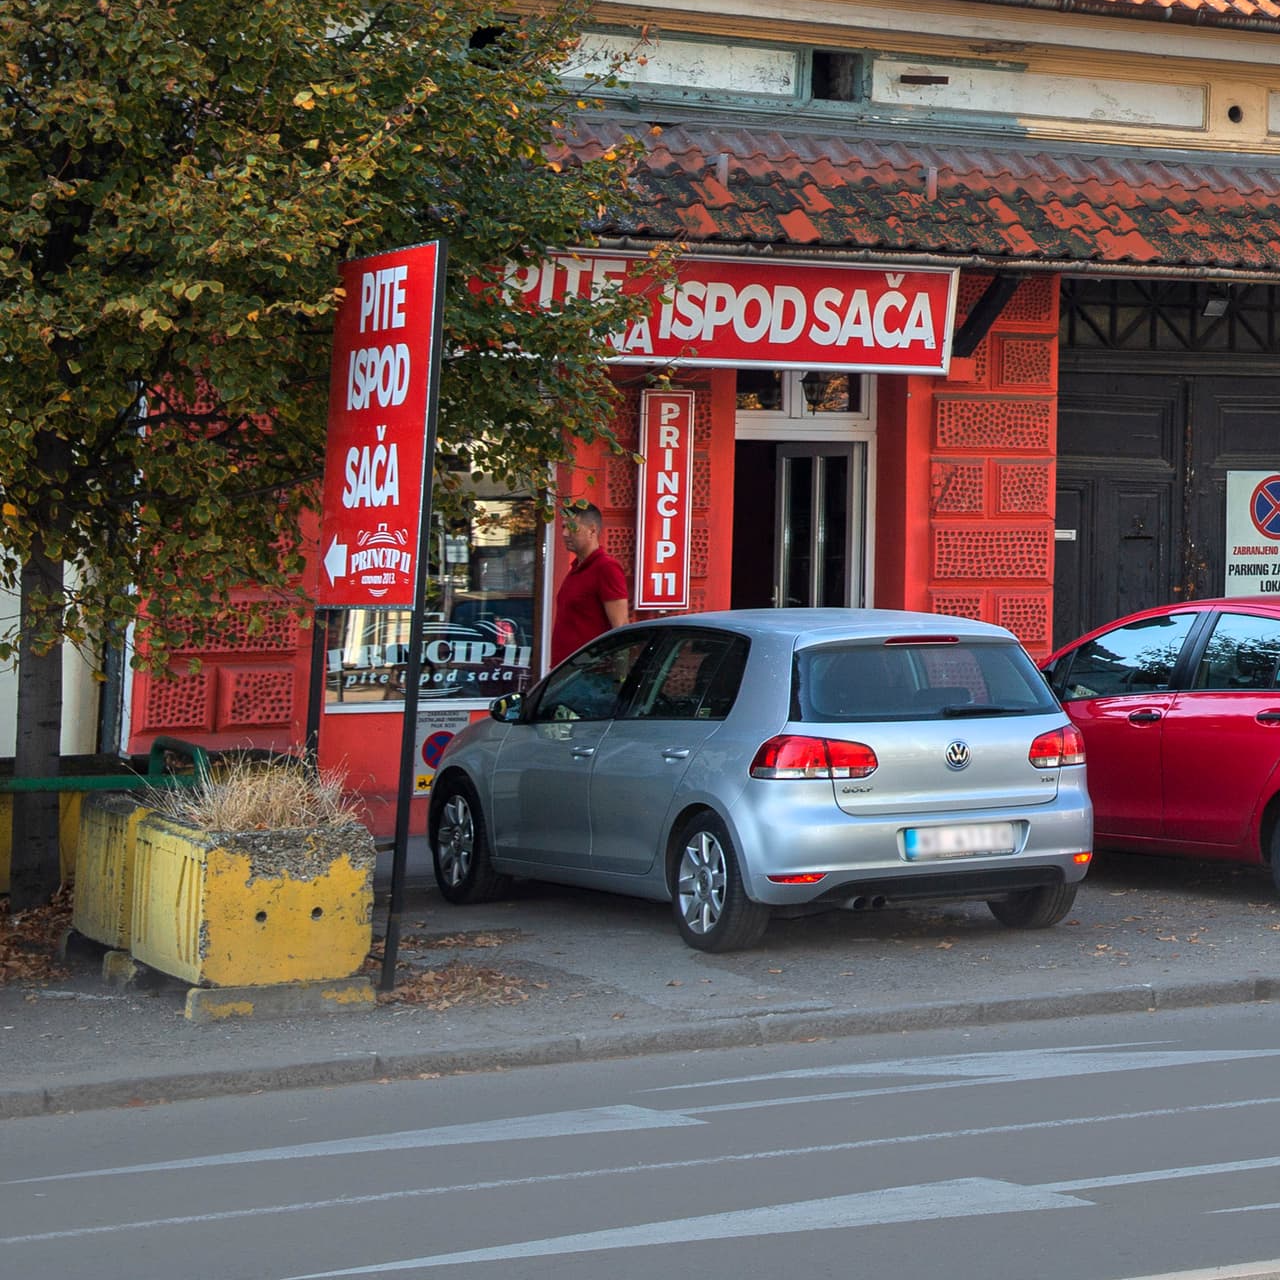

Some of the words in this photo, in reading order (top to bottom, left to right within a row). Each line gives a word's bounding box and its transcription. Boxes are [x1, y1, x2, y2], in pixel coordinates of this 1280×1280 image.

[360, 265, 406, 334] PITE
[501, 256, 627, 309] PITE
[658, 281, 806, 346] ISPOD
[808, 272, 938, 350] SAČA
[346, 342, 411, 412] ISPOD
[342, 426, 400, 509] SAČA
[658, 402, 681, 564] PRINCIP
[1229, 564, 1269, 576] PARKING
[1233, 545, 1278, 555] ZABRANJENO
[651, 571, 677, 597] 11
[345, 672, 390, 688] pite
[400, 669, 459, 685] ipod
[467, 668, 513, 682] sača
